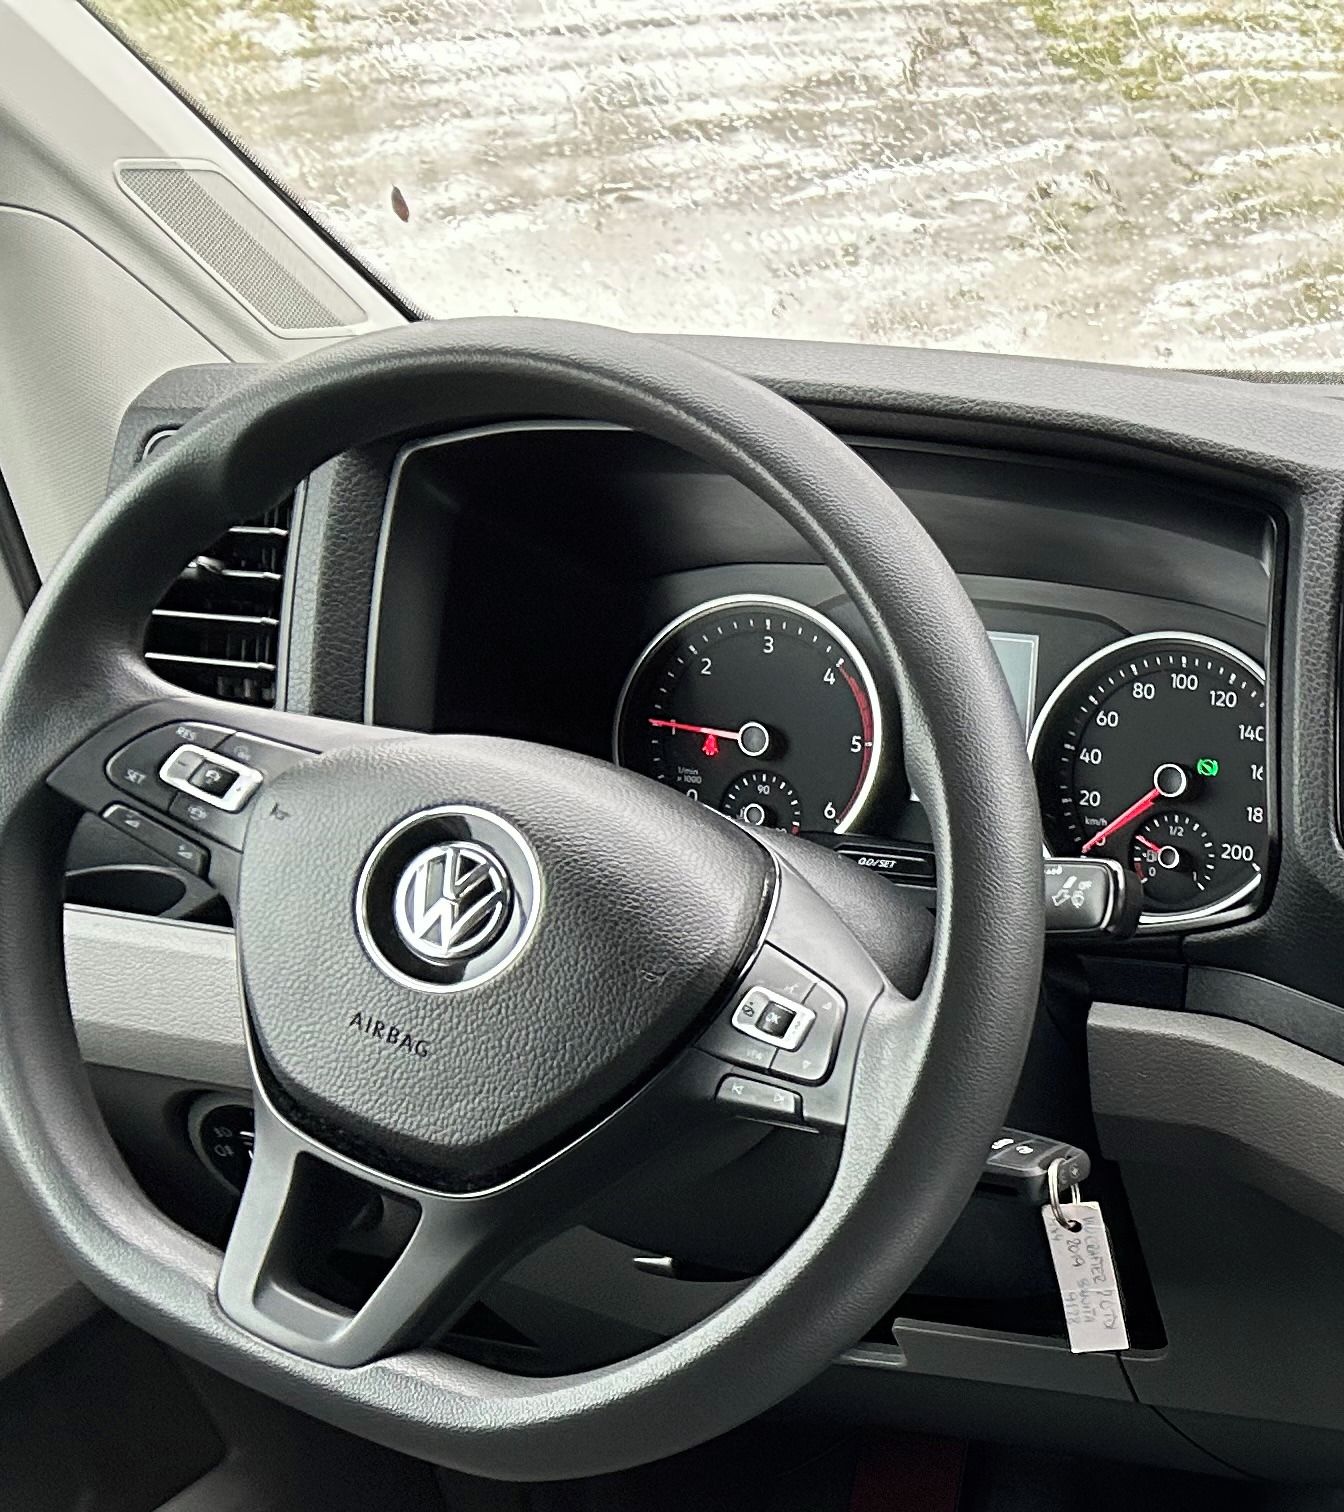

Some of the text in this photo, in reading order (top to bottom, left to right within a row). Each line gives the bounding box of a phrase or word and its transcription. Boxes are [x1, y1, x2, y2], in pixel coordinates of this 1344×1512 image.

[763, 636, 774, 653] 3
[701, 658, 712, 675] 2
[823, 669, 836, 685] 4
[1171, 673, 1198, 690] 100
[1132, 683, 1155, 699] 80
[1209, 690, 1237, 708] 120
[1096, 711, 1119, 727] 60
[850, 735, 862, 753] 5
[1079, 748, 1102, 764] 40
[1250, 764, 1264, 781] 16
[757, 784, 770, 795] 90
[1079, 790, 1101, 806] 20
[823, 802, 836, 819] 6
[1246, 806, 1264, 823] 18
[1085, 816, 1108, 826] km/h
[1169, 825, 1184, 837] 1/2
[1221, 844, 1254, 861] 200
[1148, 866, 1156, 877] 0
[349, 1011, 430, 1058] AIRBAG
